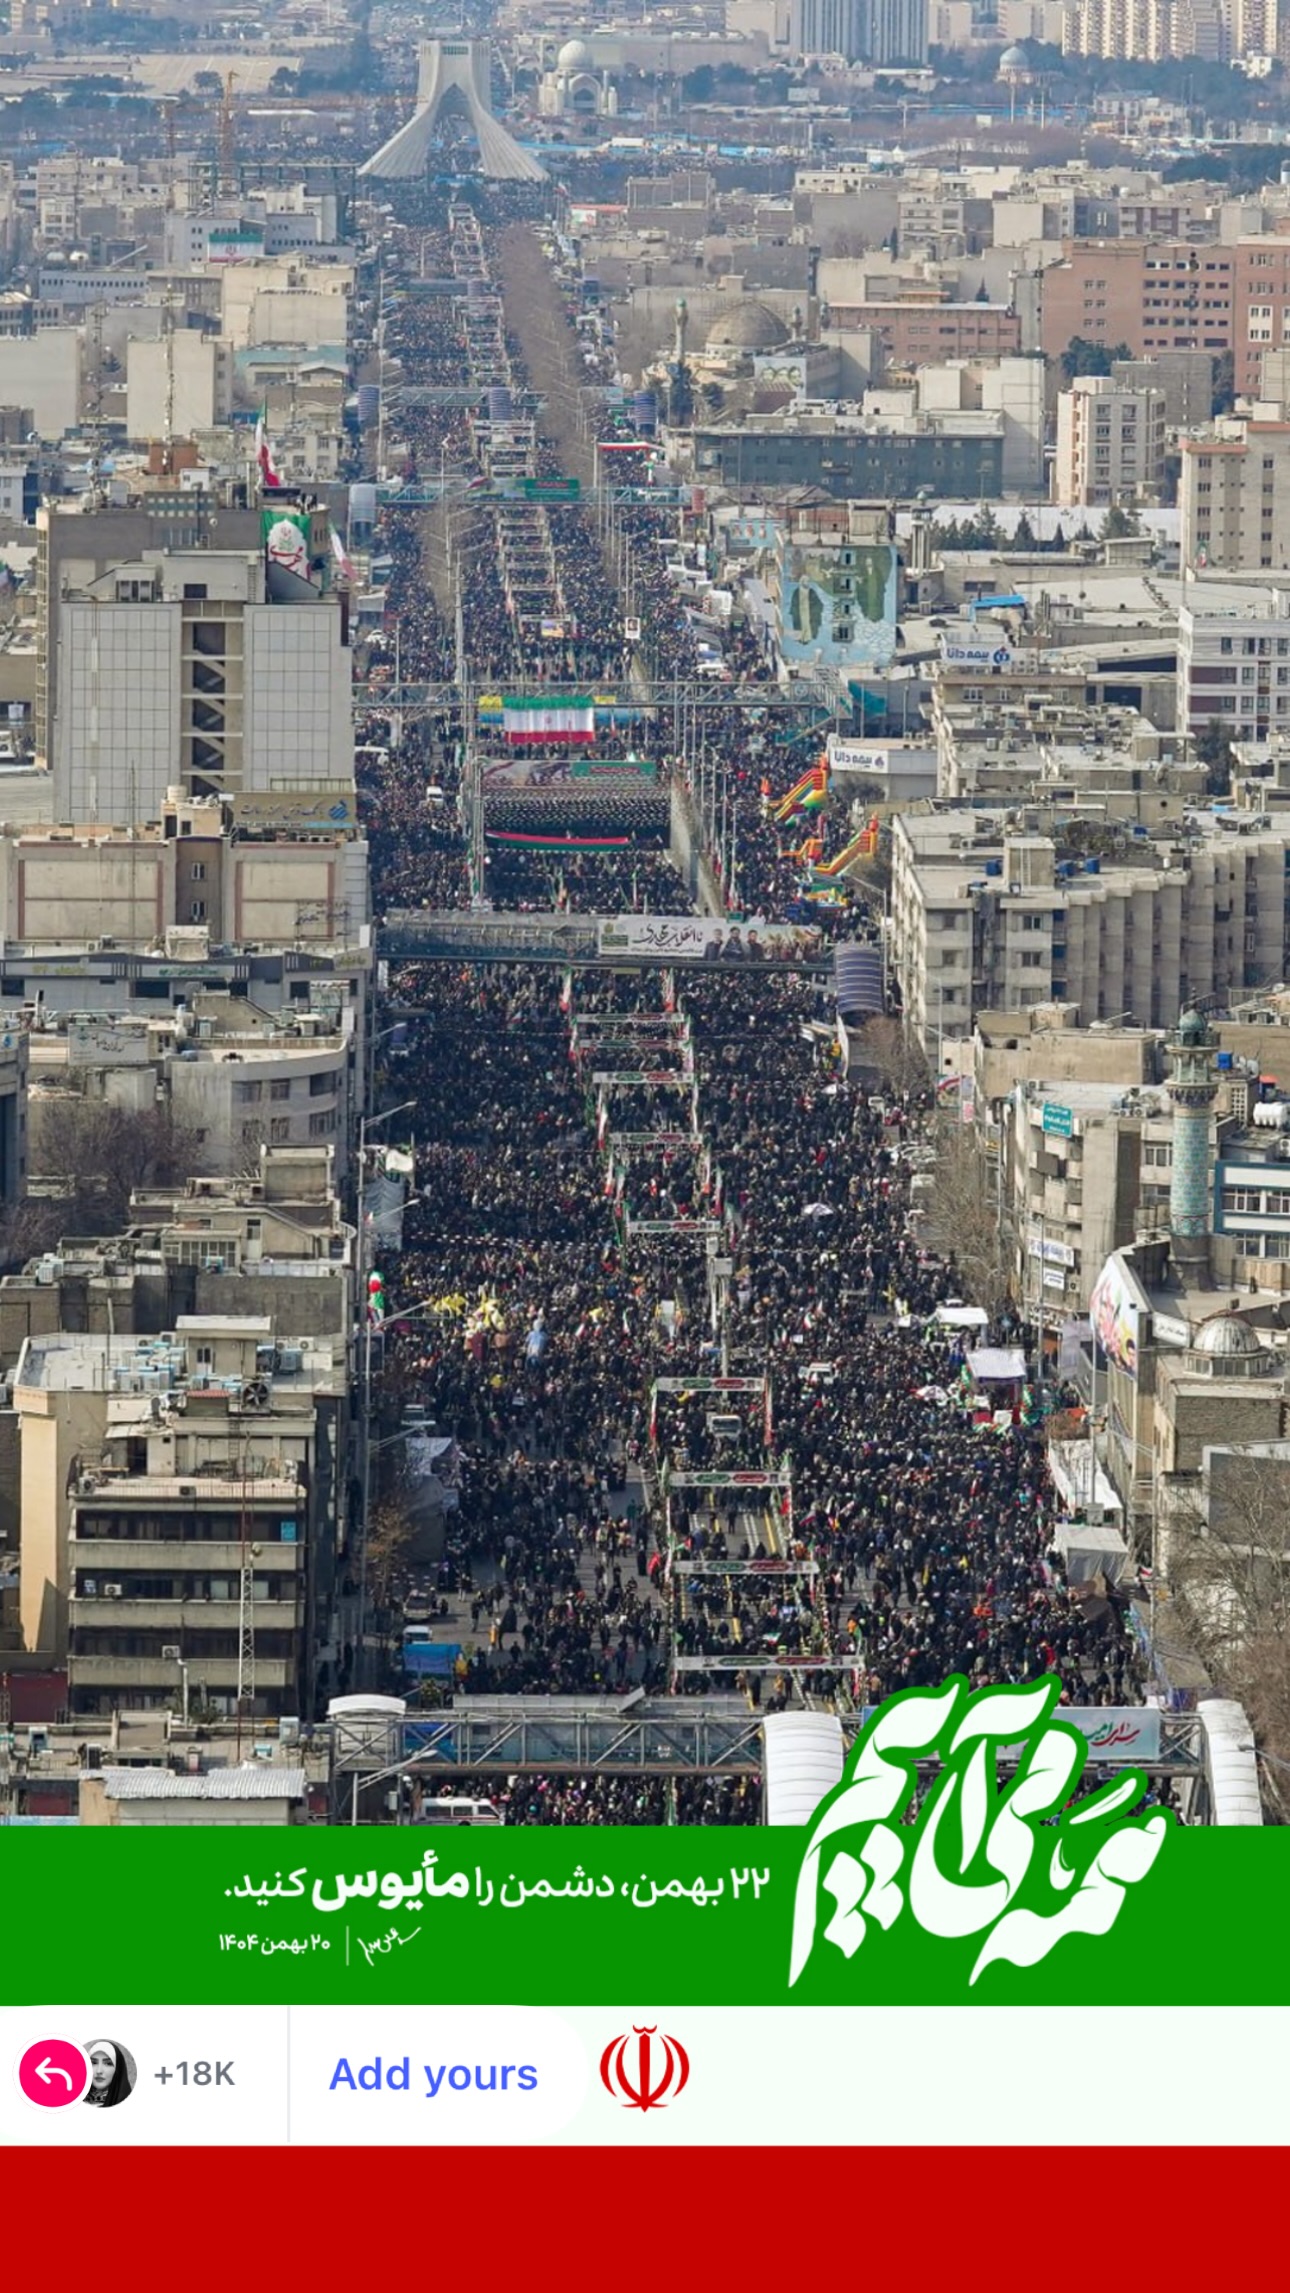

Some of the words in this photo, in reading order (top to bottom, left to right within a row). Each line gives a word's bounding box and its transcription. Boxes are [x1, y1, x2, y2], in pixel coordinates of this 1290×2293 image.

[947, 647, 965, 659] دانا
[1083, 1722, 1113, 1741] امی
[1090, 1722, 1140, 1746] سرای
